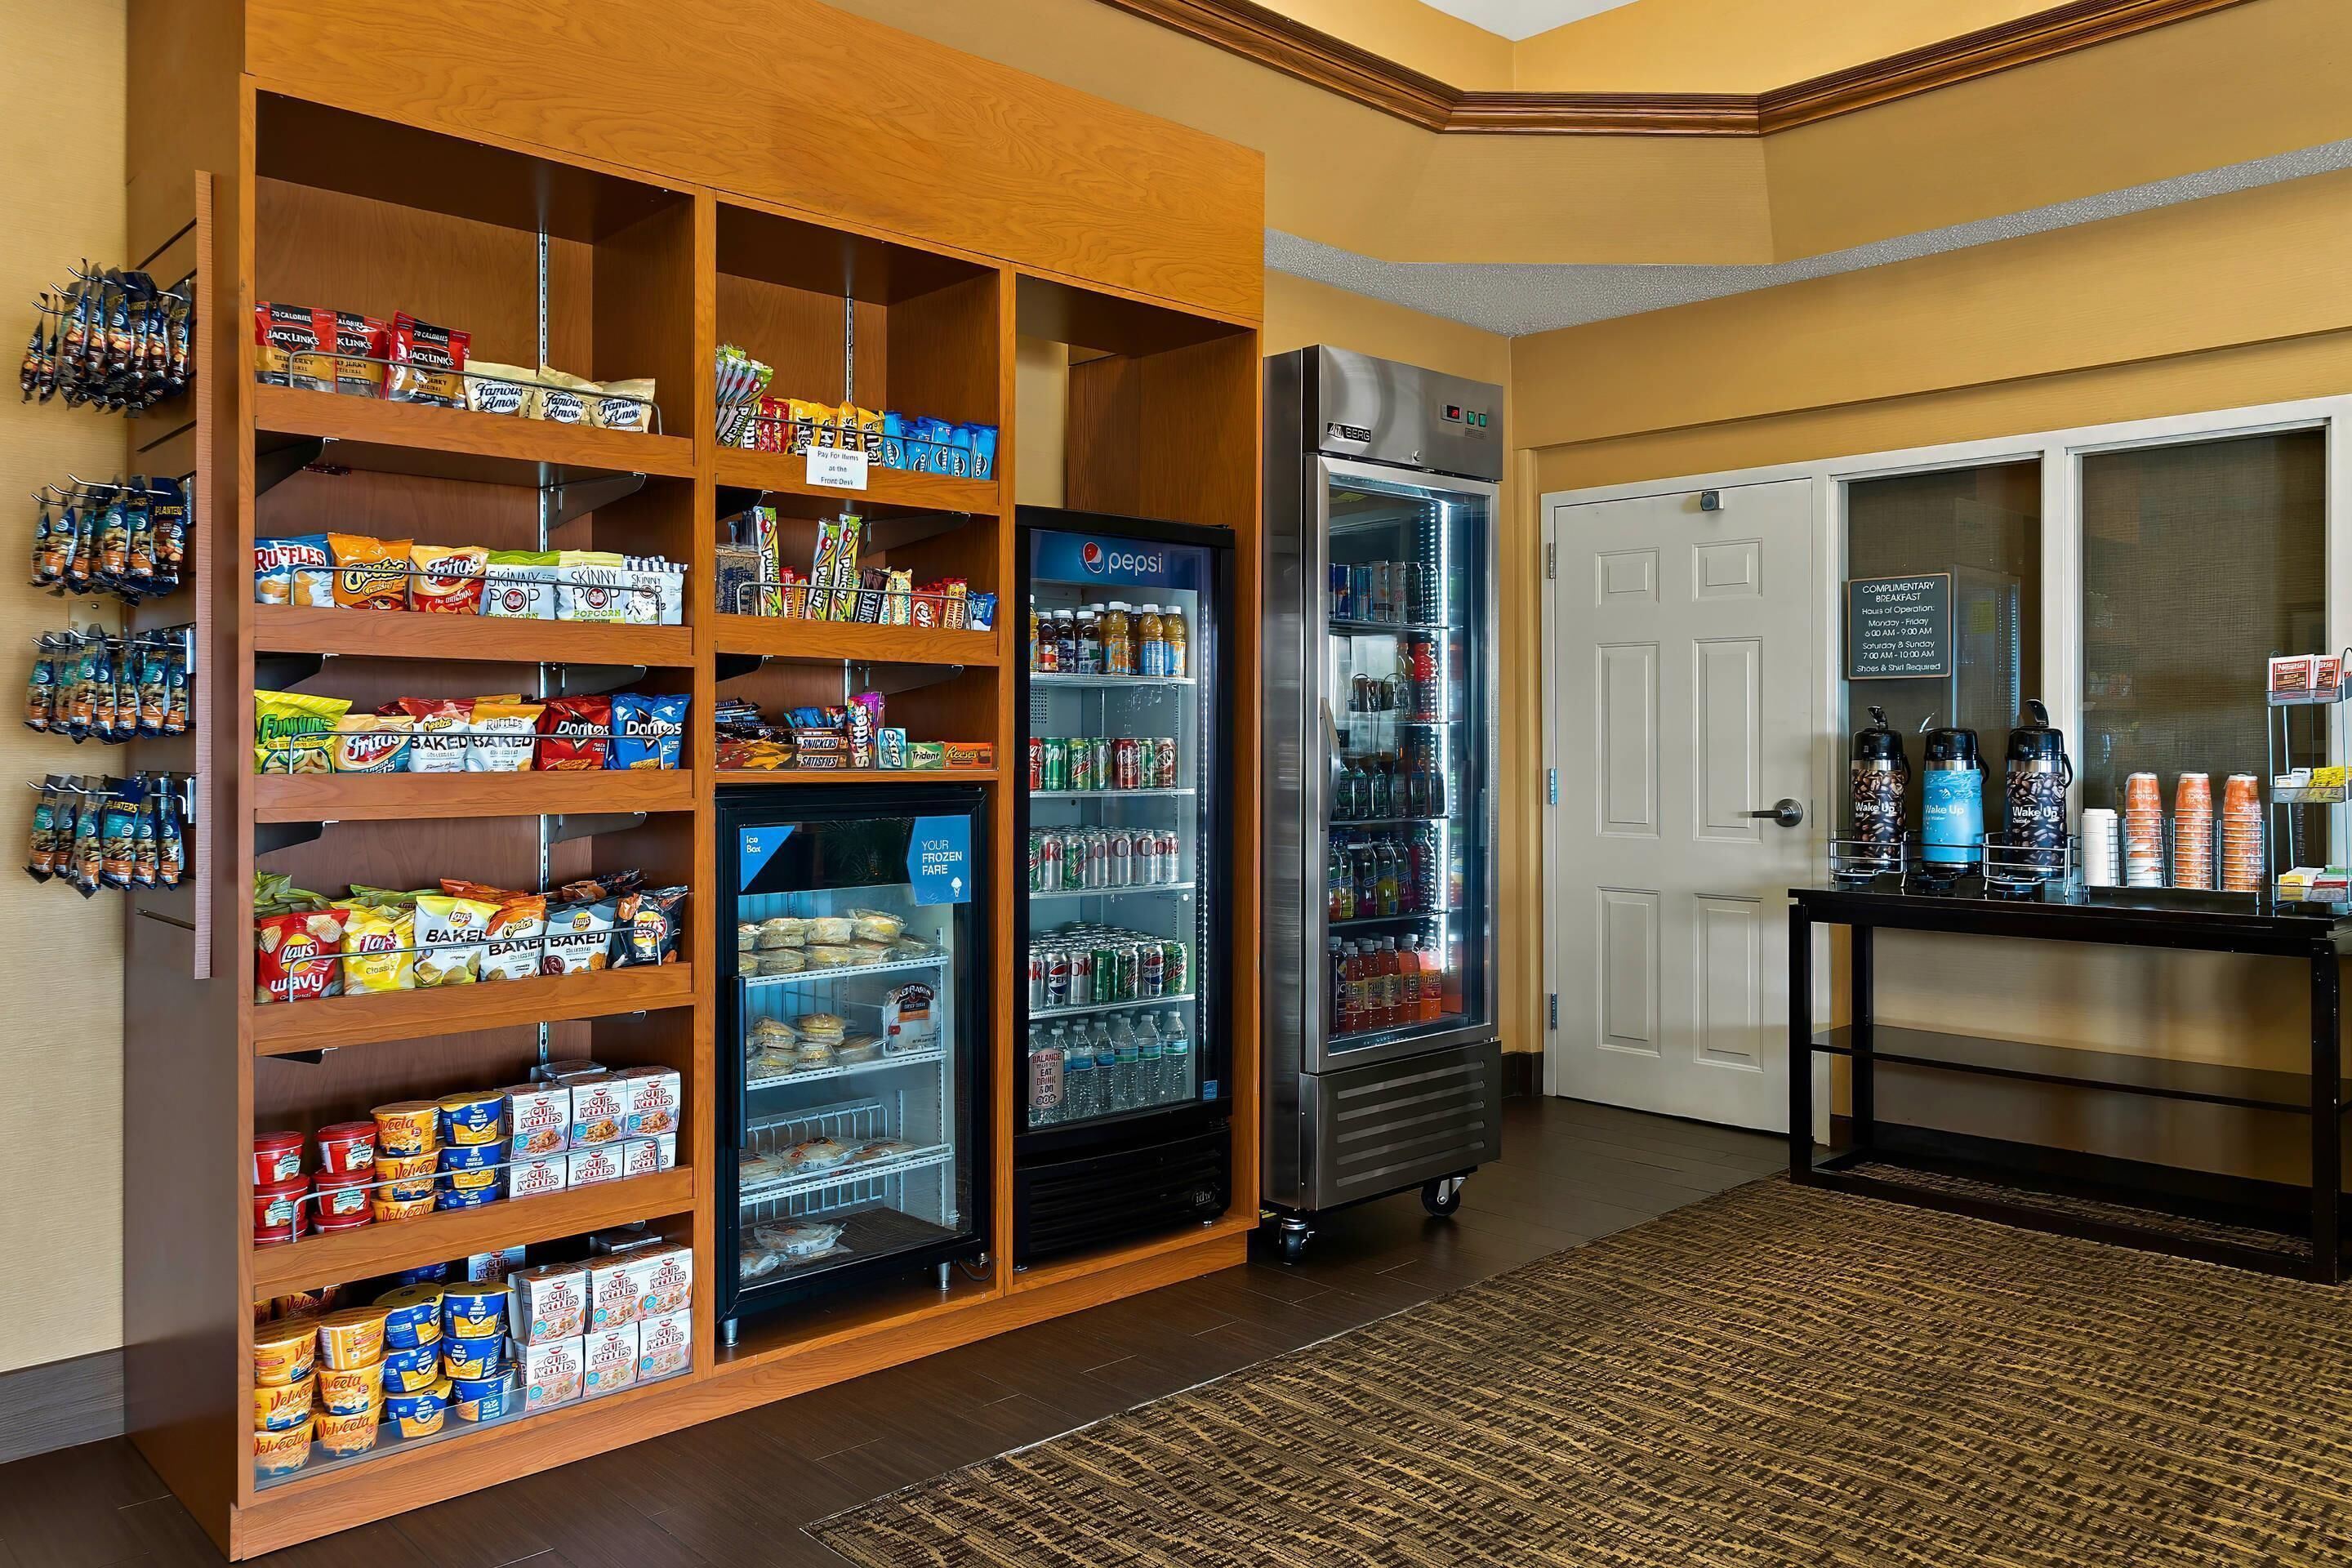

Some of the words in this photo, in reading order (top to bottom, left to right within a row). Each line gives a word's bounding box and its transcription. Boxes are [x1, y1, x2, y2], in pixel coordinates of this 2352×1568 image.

[266, 329, 291, 341] JACK
[475, 381, 523, 399] Famous
[478, 395, 519, 411] Amos
[541, 390, 583, 407] Famous
[544, 404, 580, 418] Amos
[1345, 427, 1371, 442] BERG
[817, 451, 829, 459] Pay
[821, 477, 838, 485] Front
[255, 546, 326, 572] RUFFLES
[1108, 552, 1163, 577] pepsi
[488, 568, 541, 587] SKINNY
[571, 568, 617, 586] SKINNY
[1862, 581, 1935, 594] COMPLIMENTARY
[488, 588, 541, 612] POP
[572, 586, 621, 611] POP
[1875, 593, 1922, 603] BREAKFAST
[574, 609, 621, 618] POPCORN
[1893, 605, 1935, 615] Operation:
[1905, 618, 1929, 626] Friday
[1905, 640, 1935, 648] Sunday
[1905, 662, 1940, 671] Required
[555, 720, 609, 735] Doritos
[626, 720, 682, 735] Doritos
[411, 736, 468, 751] BAKED
[473, 736, 532, 748] BAKED
[801, 737, 839, 750] SNICKERS
[911, 750, 939, 760] Trident
[945, 746, 978, 760] Reese's
[1855, 802, 1878, 813] Wake
[1881, 803, 1895, 816] Up
[1924, 804, 1947, 814] Wake
[1949, 806, 1964, 817] Up
[2012, 806, 2041, 817] Wake
[2043, 808, 2058, 820] Up
[921, 840, 949, 850] YOUR
[922, 851, 963, 863] FROZEN
[922, 864, 948, 875] FARE
[502, 918, 533, 939] Cheetos
[550, 933, 606, 947] BAKED
